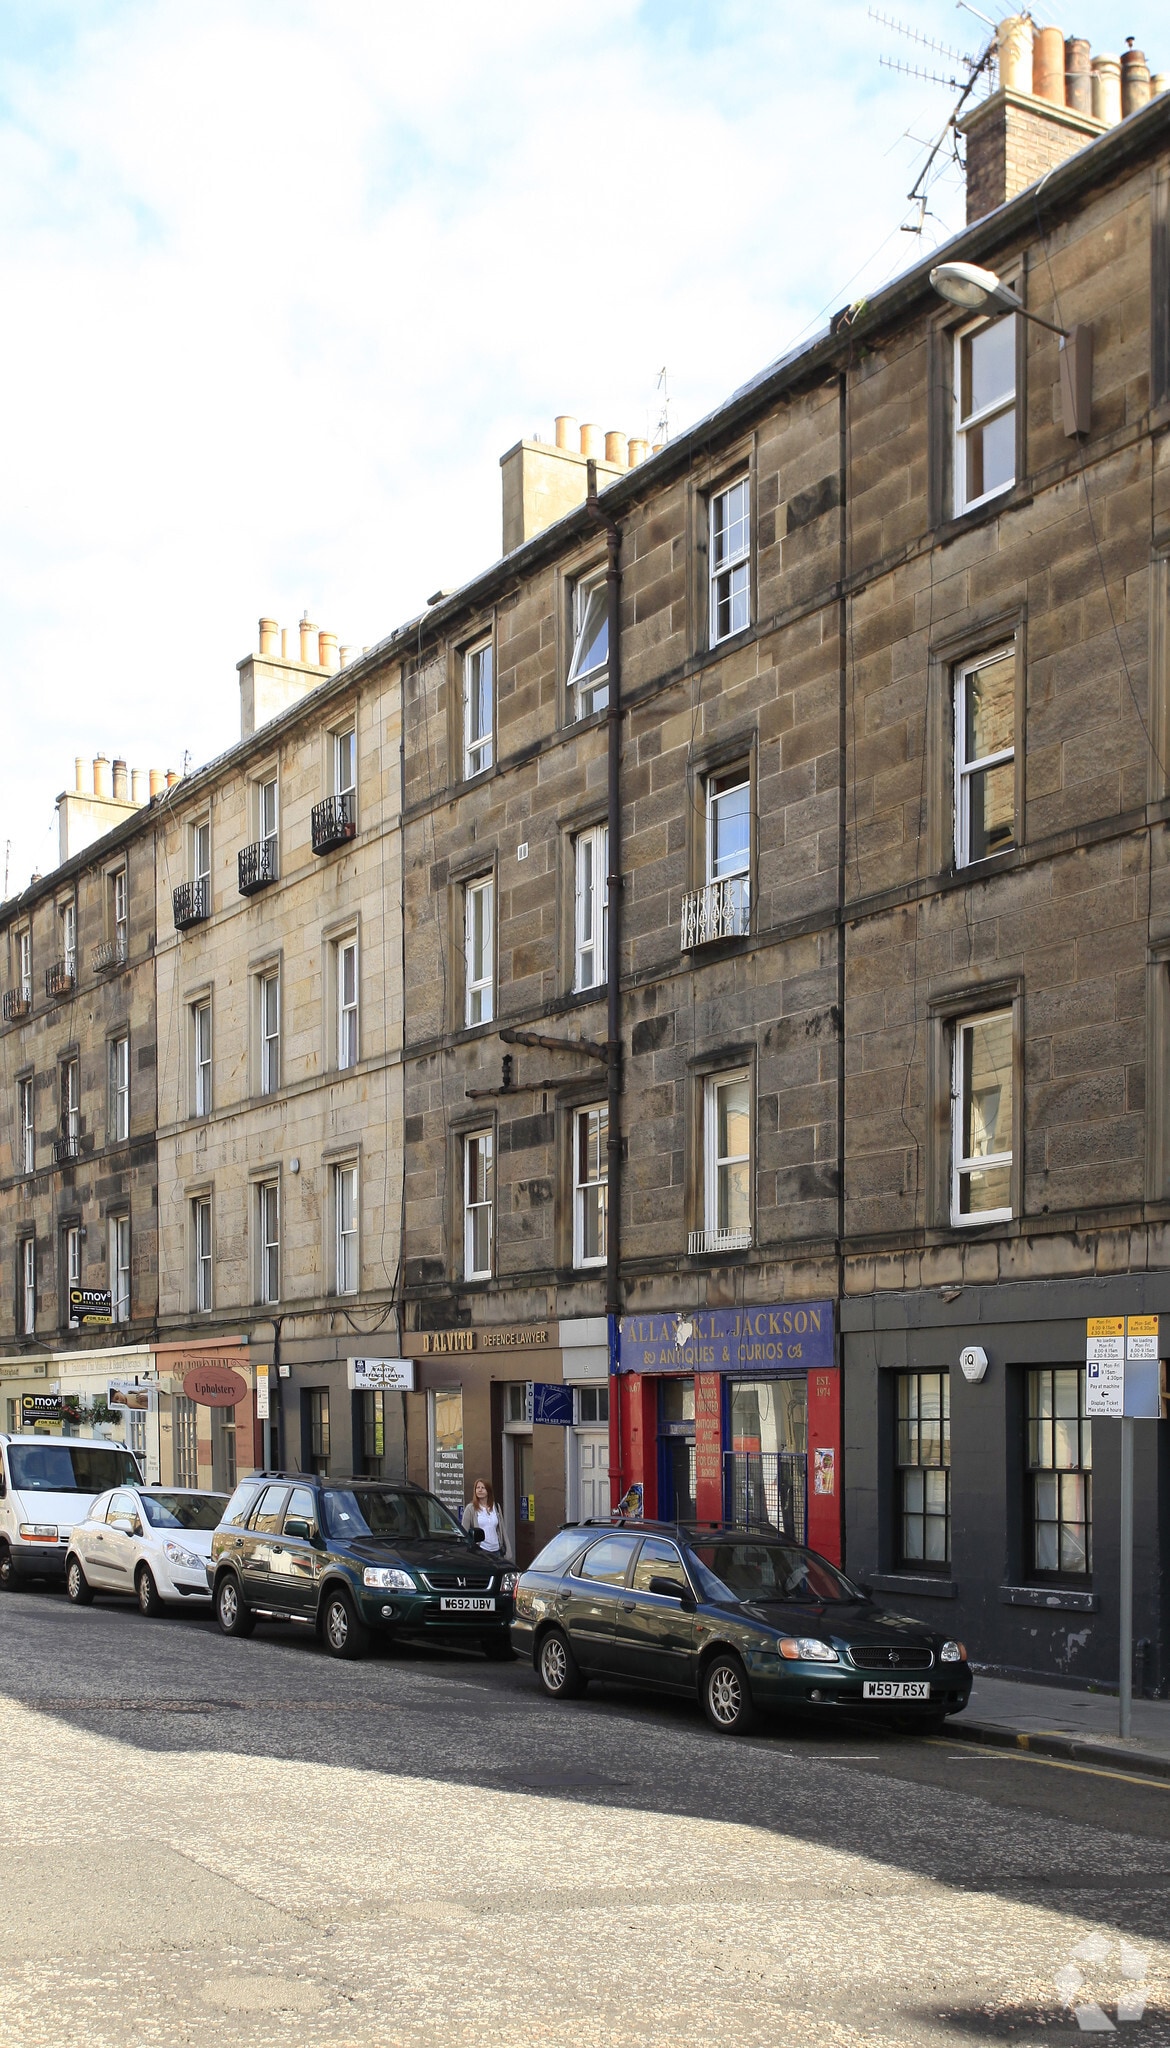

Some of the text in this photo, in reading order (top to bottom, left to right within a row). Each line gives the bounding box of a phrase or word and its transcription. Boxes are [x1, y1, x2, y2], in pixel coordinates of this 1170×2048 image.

[733, 1310, 821, 1337] JACKSON
[483, 1334, 515, 1346] DEFENCE
[516, 1331, 546, 1344] LAWYER
[660, 1342, 783, 1365] ANTIQUES & CURIOS
[816, 1377, 830, 1385] EST.
[195, 1382, 236, 1397] Upholstery
[817, 1388, 830, 1397] 1974
[697, 1401, 719, 1412] WANTED
[696, 1419, 718, 1429] ANTIQUES
[697, 1456, 706, 1466] FOR
[445, 1599, 491, 1609] W692 UBV
[869, 1683, 925, 1696] W597 RSX
